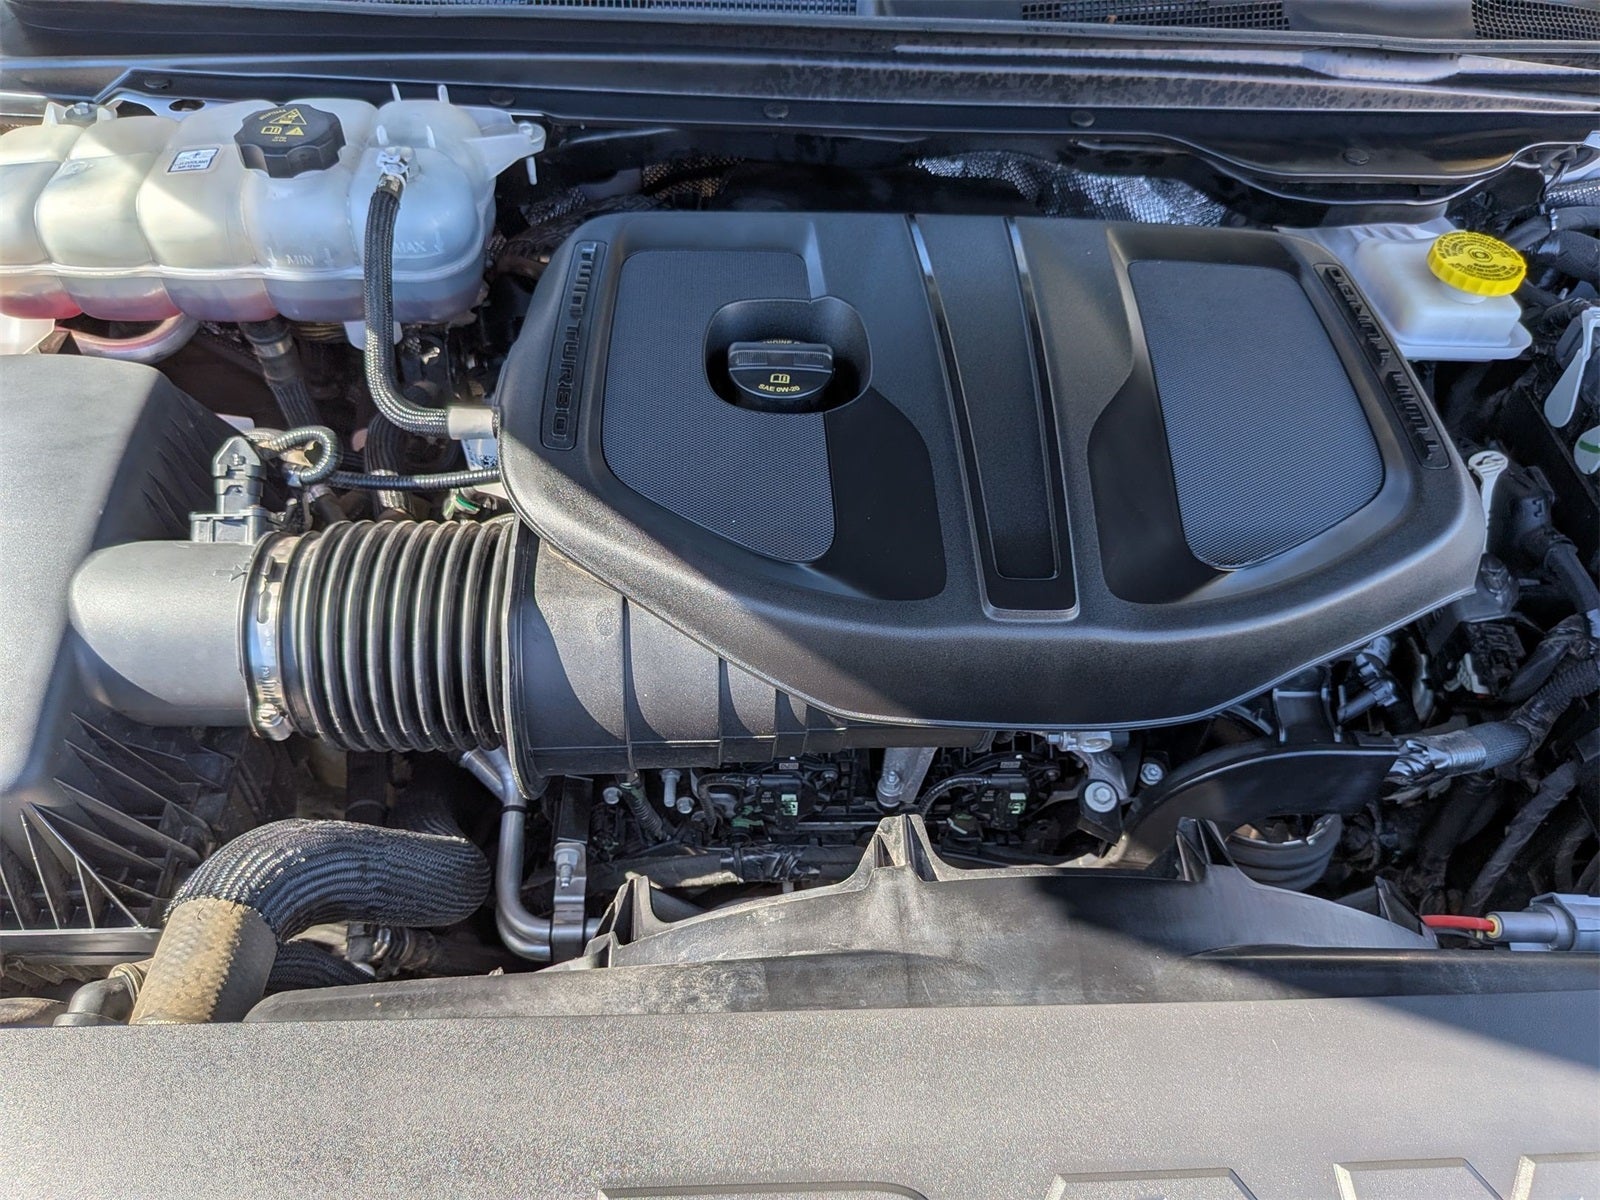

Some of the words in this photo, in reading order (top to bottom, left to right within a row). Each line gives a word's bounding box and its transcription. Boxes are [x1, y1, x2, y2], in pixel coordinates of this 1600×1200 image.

[286, 254, 314, 265] MIN
[570, 242, 597, 317] TWIN
[551, 320, 581, 439] TURBO
[758, 383, 775, 392] SAE
